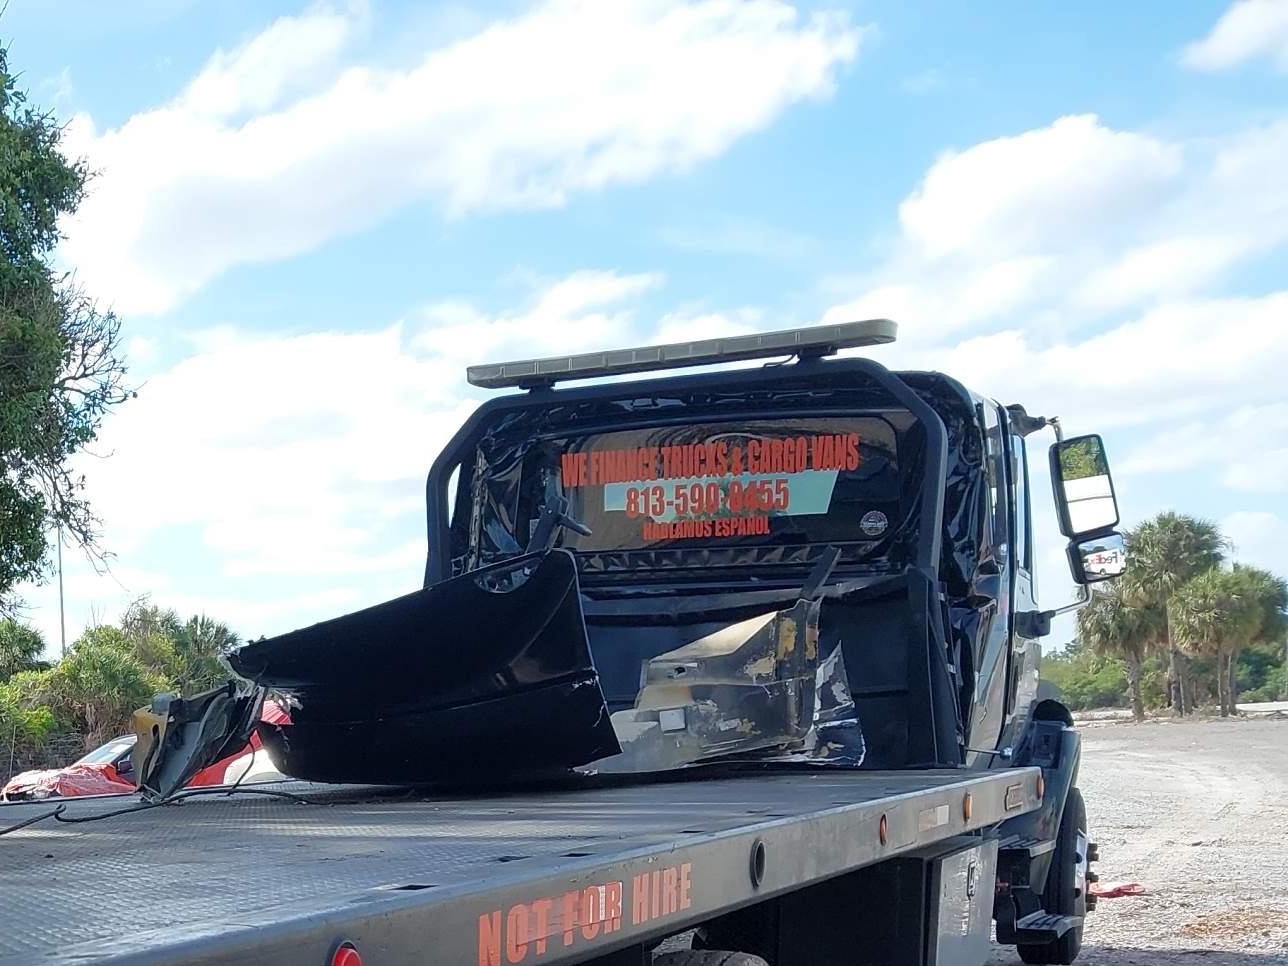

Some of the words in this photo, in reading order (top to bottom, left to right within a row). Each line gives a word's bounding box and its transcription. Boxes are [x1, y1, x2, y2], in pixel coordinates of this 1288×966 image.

[562, 453, 587, 488] WE
[591, 447, 658, 485] FINANCE
[661, 440, 728, 480] TRUCKS
[731, 446, 744, 476] &
[747, 436, 808, 474] CARGO
[811, 432, 860, 471] VANS
[563, 880, 623, 946] FOR
[632, 862, 693, 925] HIRE
